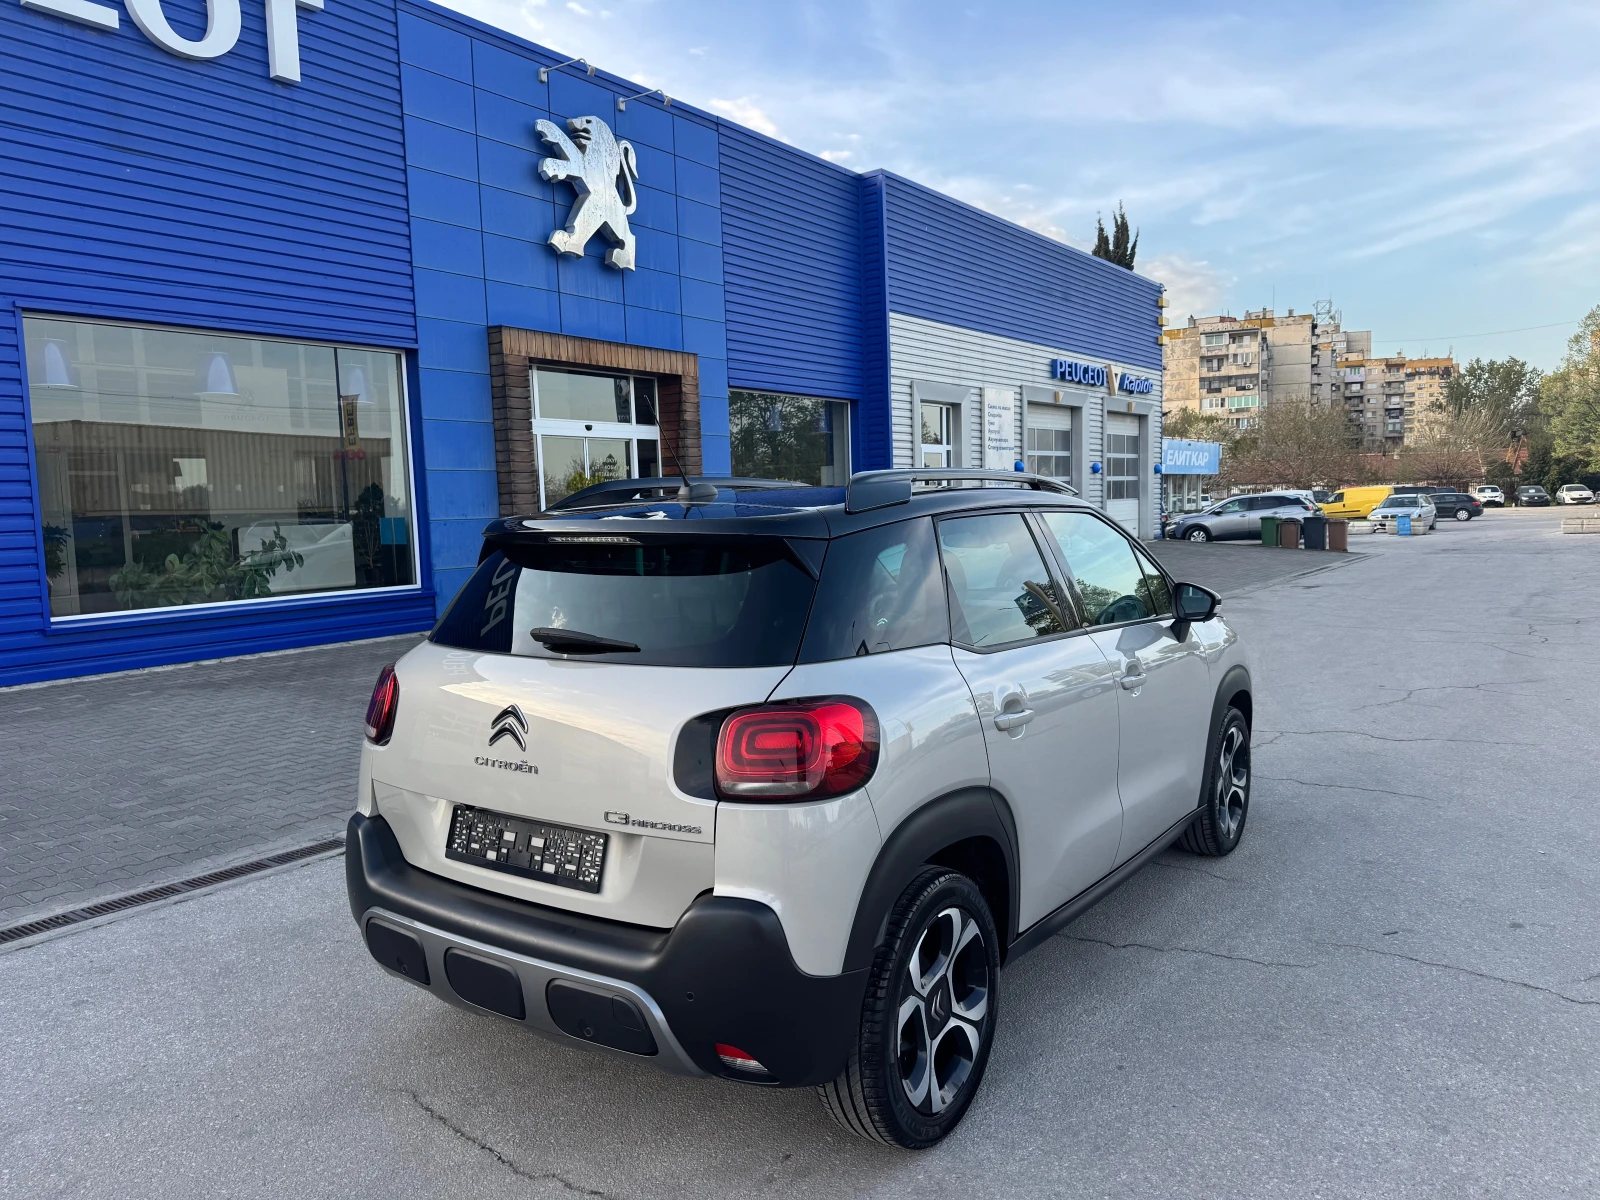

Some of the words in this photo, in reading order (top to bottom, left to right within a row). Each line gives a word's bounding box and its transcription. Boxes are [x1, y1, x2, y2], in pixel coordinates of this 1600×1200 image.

[1056, 359, 1108, 387] PEUGEOT
[603, 809, 629, 826] C3
[631, 818, 702, 834] AIRCROSS
